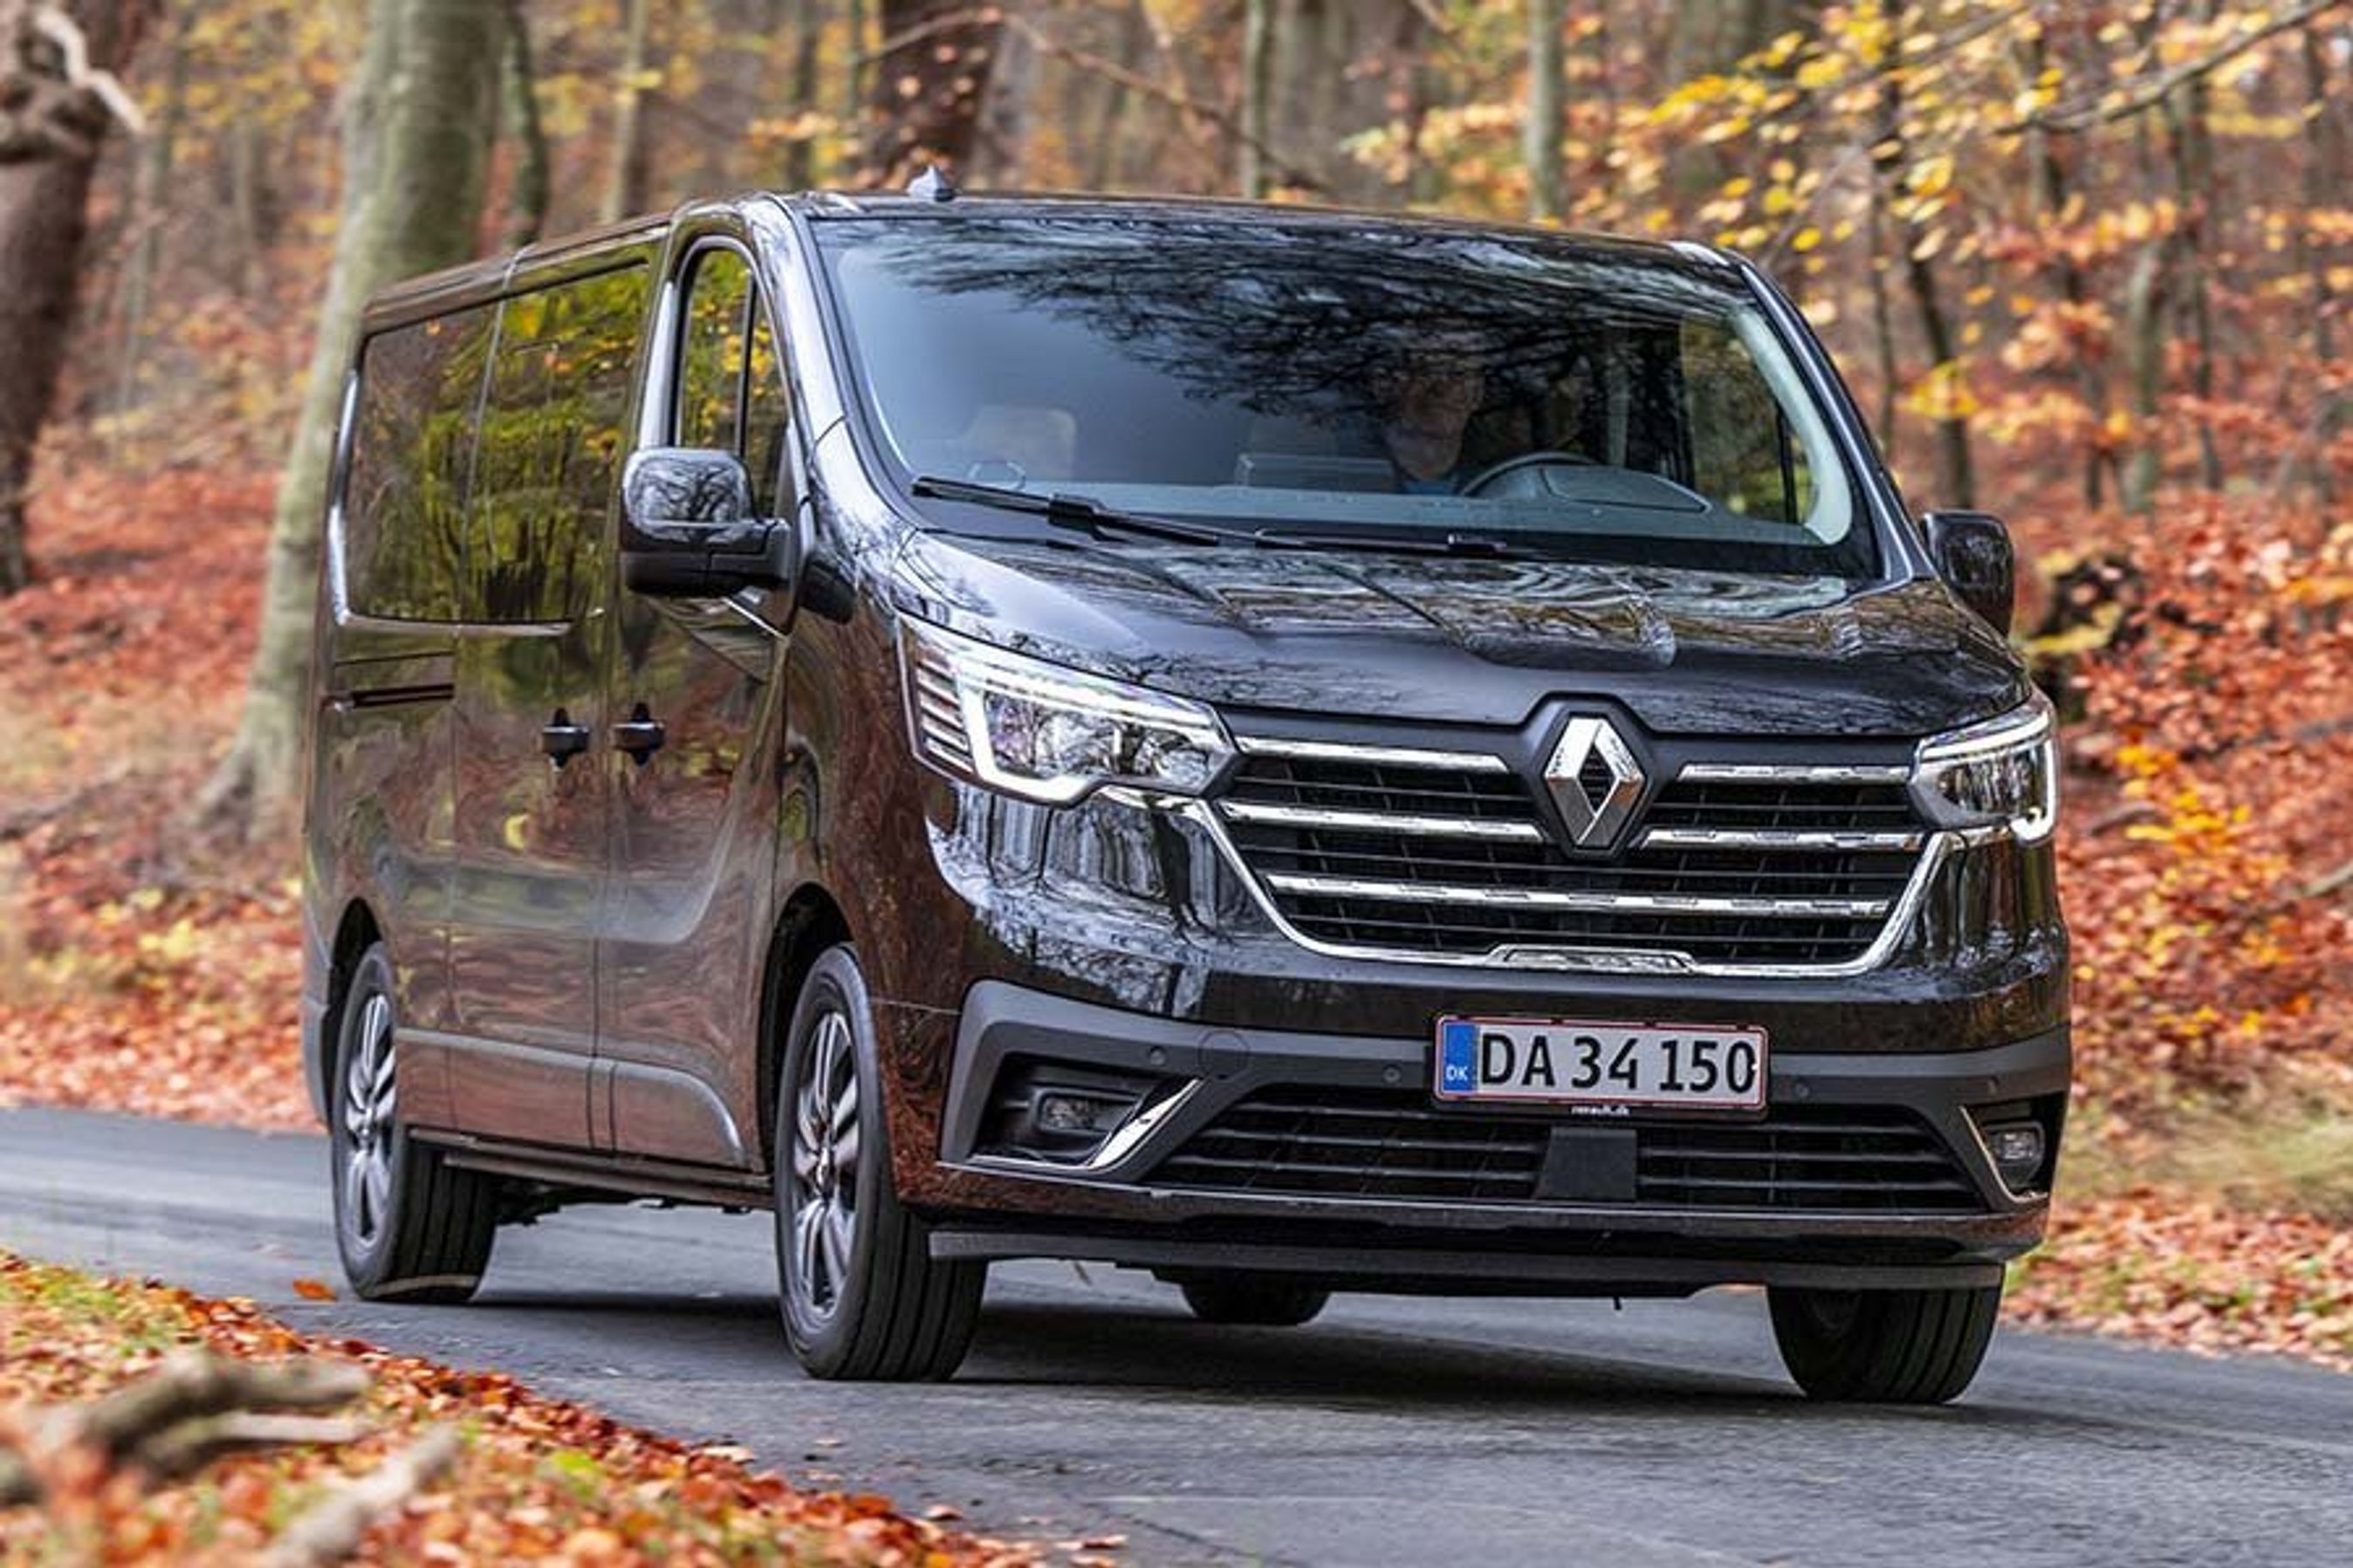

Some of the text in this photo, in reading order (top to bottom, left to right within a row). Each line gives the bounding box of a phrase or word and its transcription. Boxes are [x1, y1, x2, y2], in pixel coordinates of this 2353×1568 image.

[1446, 1065, 1468, 1081] DK
[1482, 1034, 1756, 1092] DA 34 150
